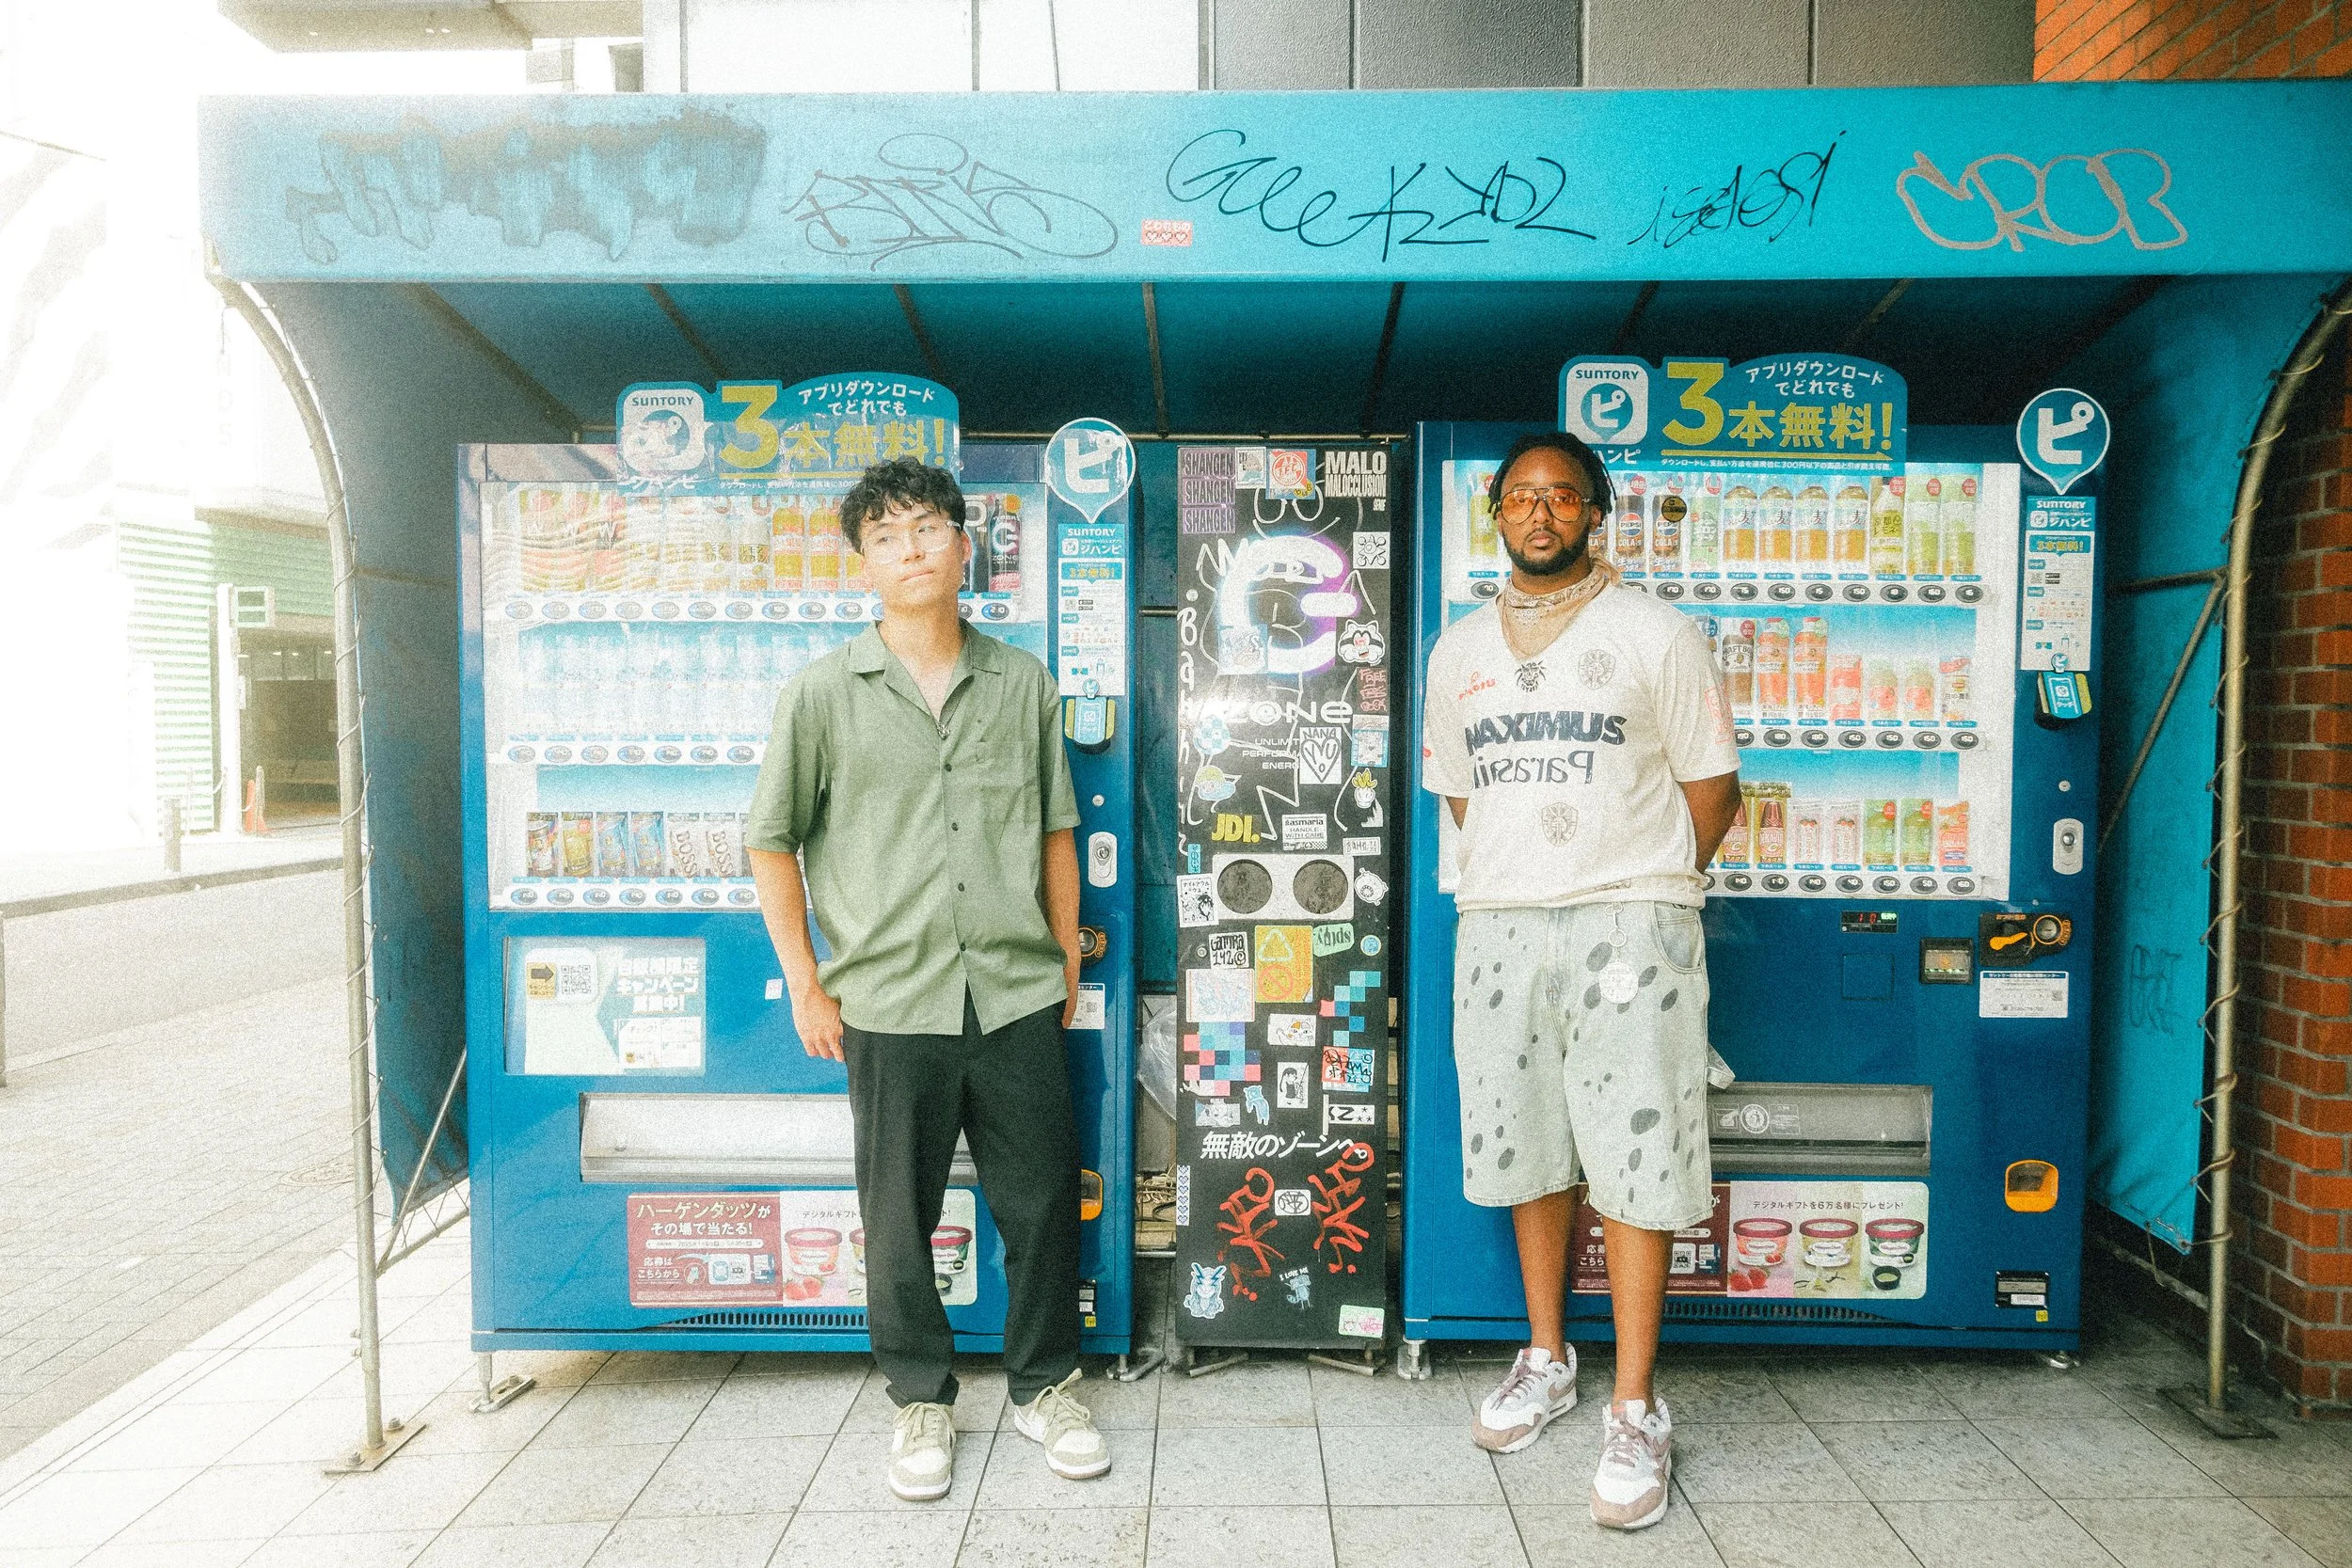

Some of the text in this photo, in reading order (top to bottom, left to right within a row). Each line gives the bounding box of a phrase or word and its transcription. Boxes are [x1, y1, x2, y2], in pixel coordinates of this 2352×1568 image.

[1576, 370, 1640, 380] SUNTORY
[1746, 360, 1884, 385] アプリダウンロード
[799, 380, 936, 404] アプリダウンロード
[1775, 380, 1854, 399] でどれでも
[632, 396, 694, 406] SUNTORY
[828, 399, 907, 417] でどれでも
[1661, 362, 1893, 450] 3本無料!
[1325, 451, 1388, 474] MALO
[1325, 474, 1387, 498] MALOCCLUSION
[2037, 500, 2086, 509] SUNTORY
[1068, 528, 1116, 536] SUNTORY
[1302, 727, 1337, 738] NANA
[676, 831, 698, 878] BOSS
[712, 831, 734, 878] BOSS
[637, 1201, 771, 1220] ハーゲンダッツが
[651, 1223, 754, 1236] その場で当たる!
[638, 1268, 680, 1279] こちらから
